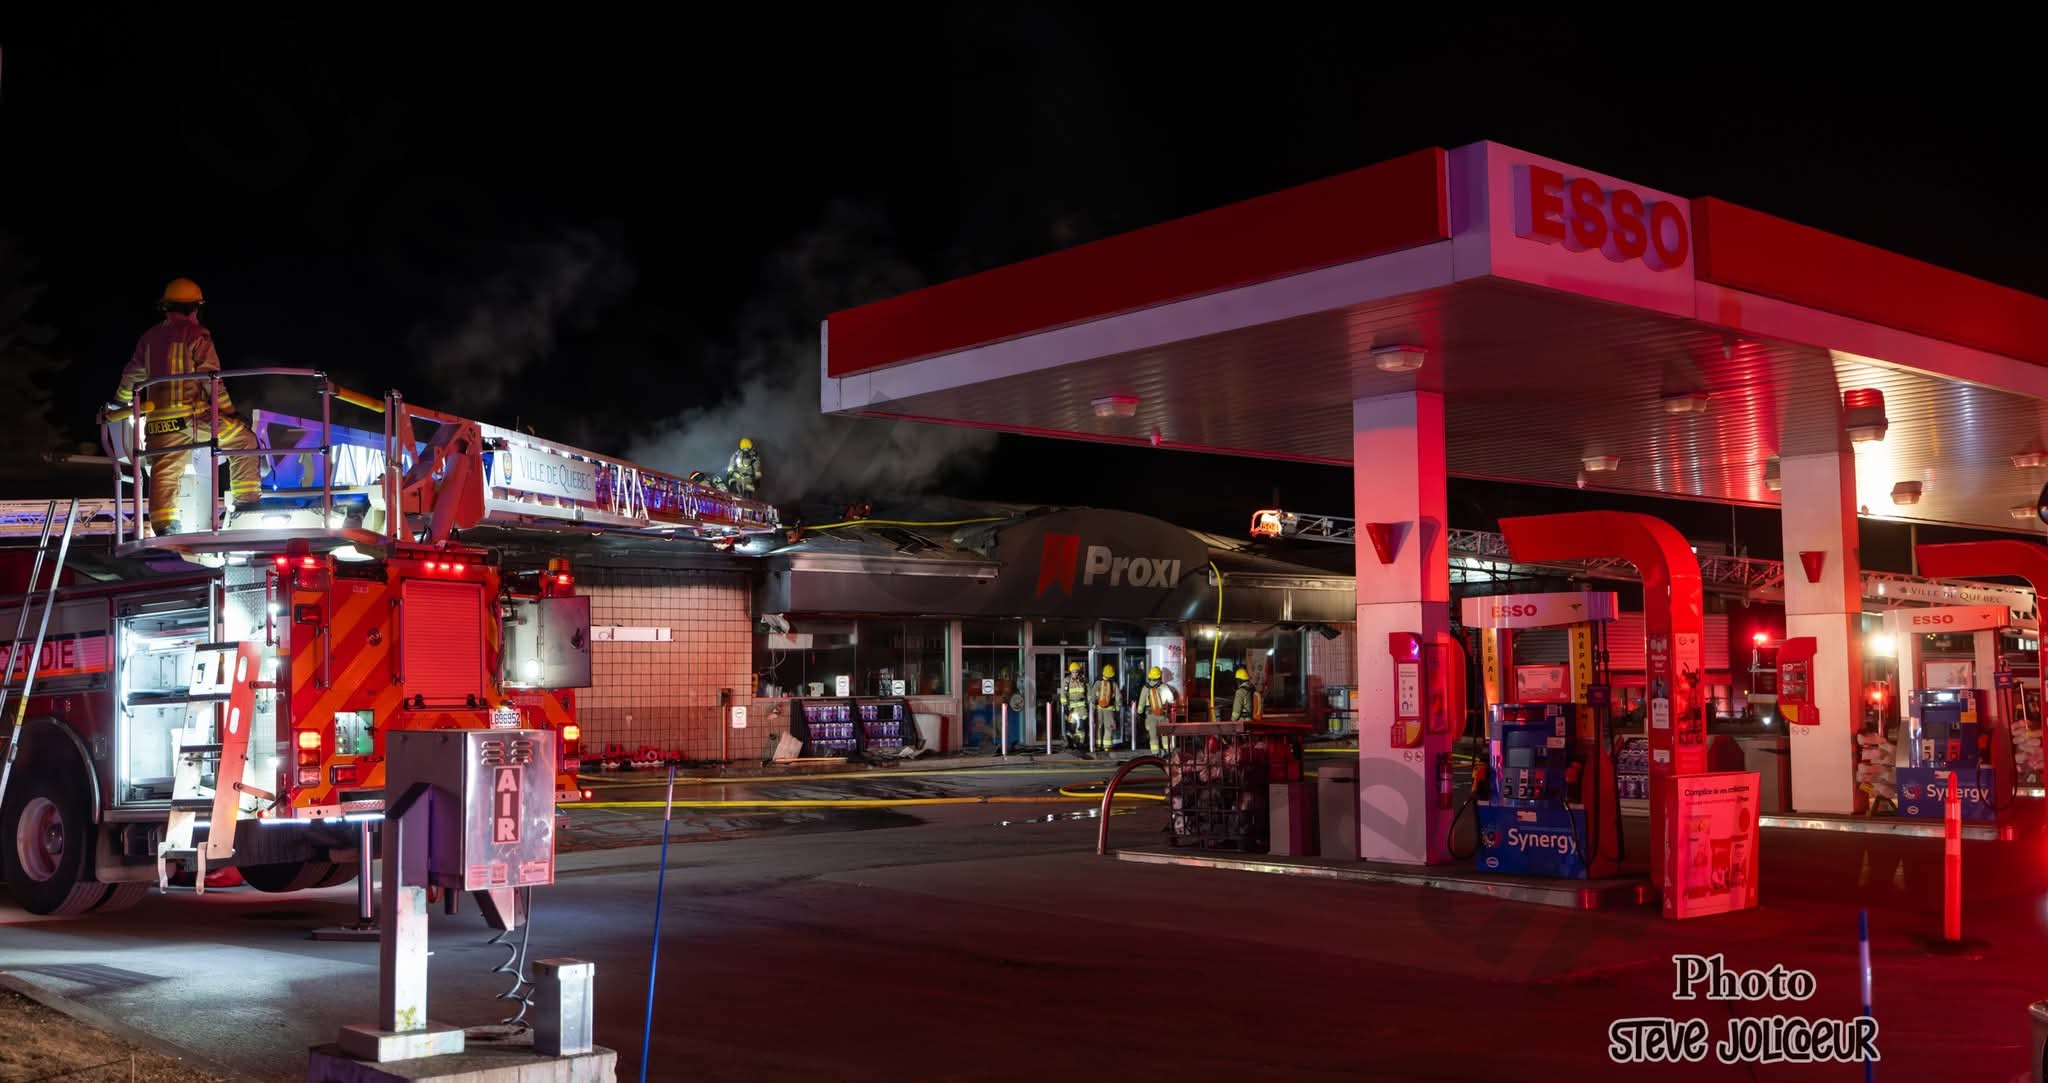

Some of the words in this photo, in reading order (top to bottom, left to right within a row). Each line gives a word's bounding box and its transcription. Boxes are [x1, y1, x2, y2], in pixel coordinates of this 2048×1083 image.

[1515, 165, 1689, 271] ESSO
[520, 455, 545, 482] VILLE
[547, 465, 558, 485] DE
[1491, 604, 1537, 617] ESSO
[1912, 614, 1954, 625] ESSO
[497, 769, 518, 841] AIR
[1926, 784, 1990, 803] Syergy
[1508, 828, 1577, 854] Synergy
